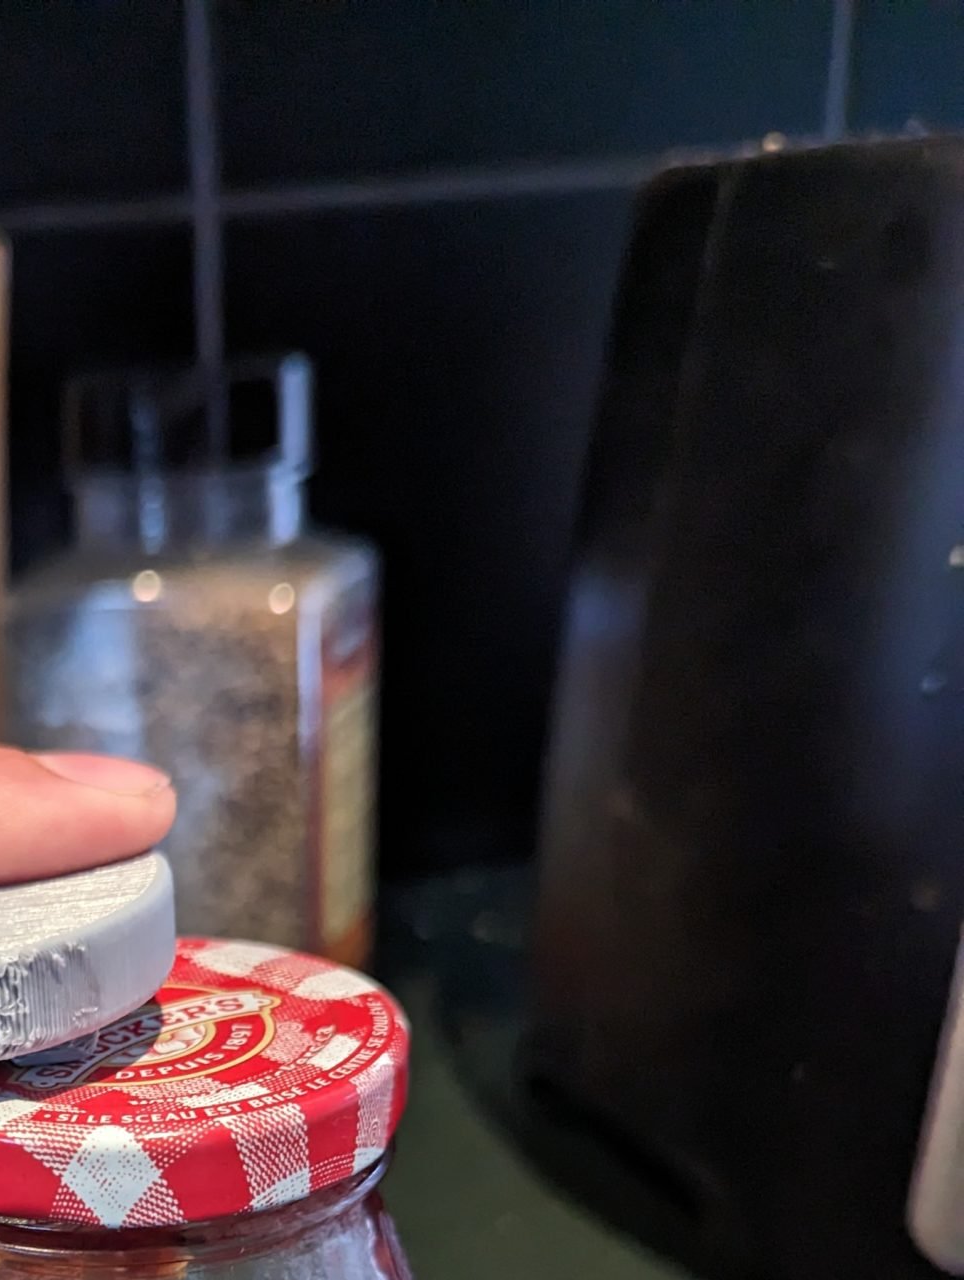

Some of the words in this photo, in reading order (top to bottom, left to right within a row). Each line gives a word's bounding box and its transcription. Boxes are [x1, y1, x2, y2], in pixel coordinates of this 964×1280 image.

[56, 1113, 79, 1123] SI
[86, 1114, 113, 1124] LE
[121, 1110, 197, 1124] SCEAU
[204, 1103, 242, 1117] EST
[306, 1077, 333, 1090] LE
[328, 1048, 377, 1080] CENTRE
[366, 1036, 386, 1049] SE
[115, 1051, 224, 1080] DEPUIS
[222, 1023, 253, 1051] 1897
